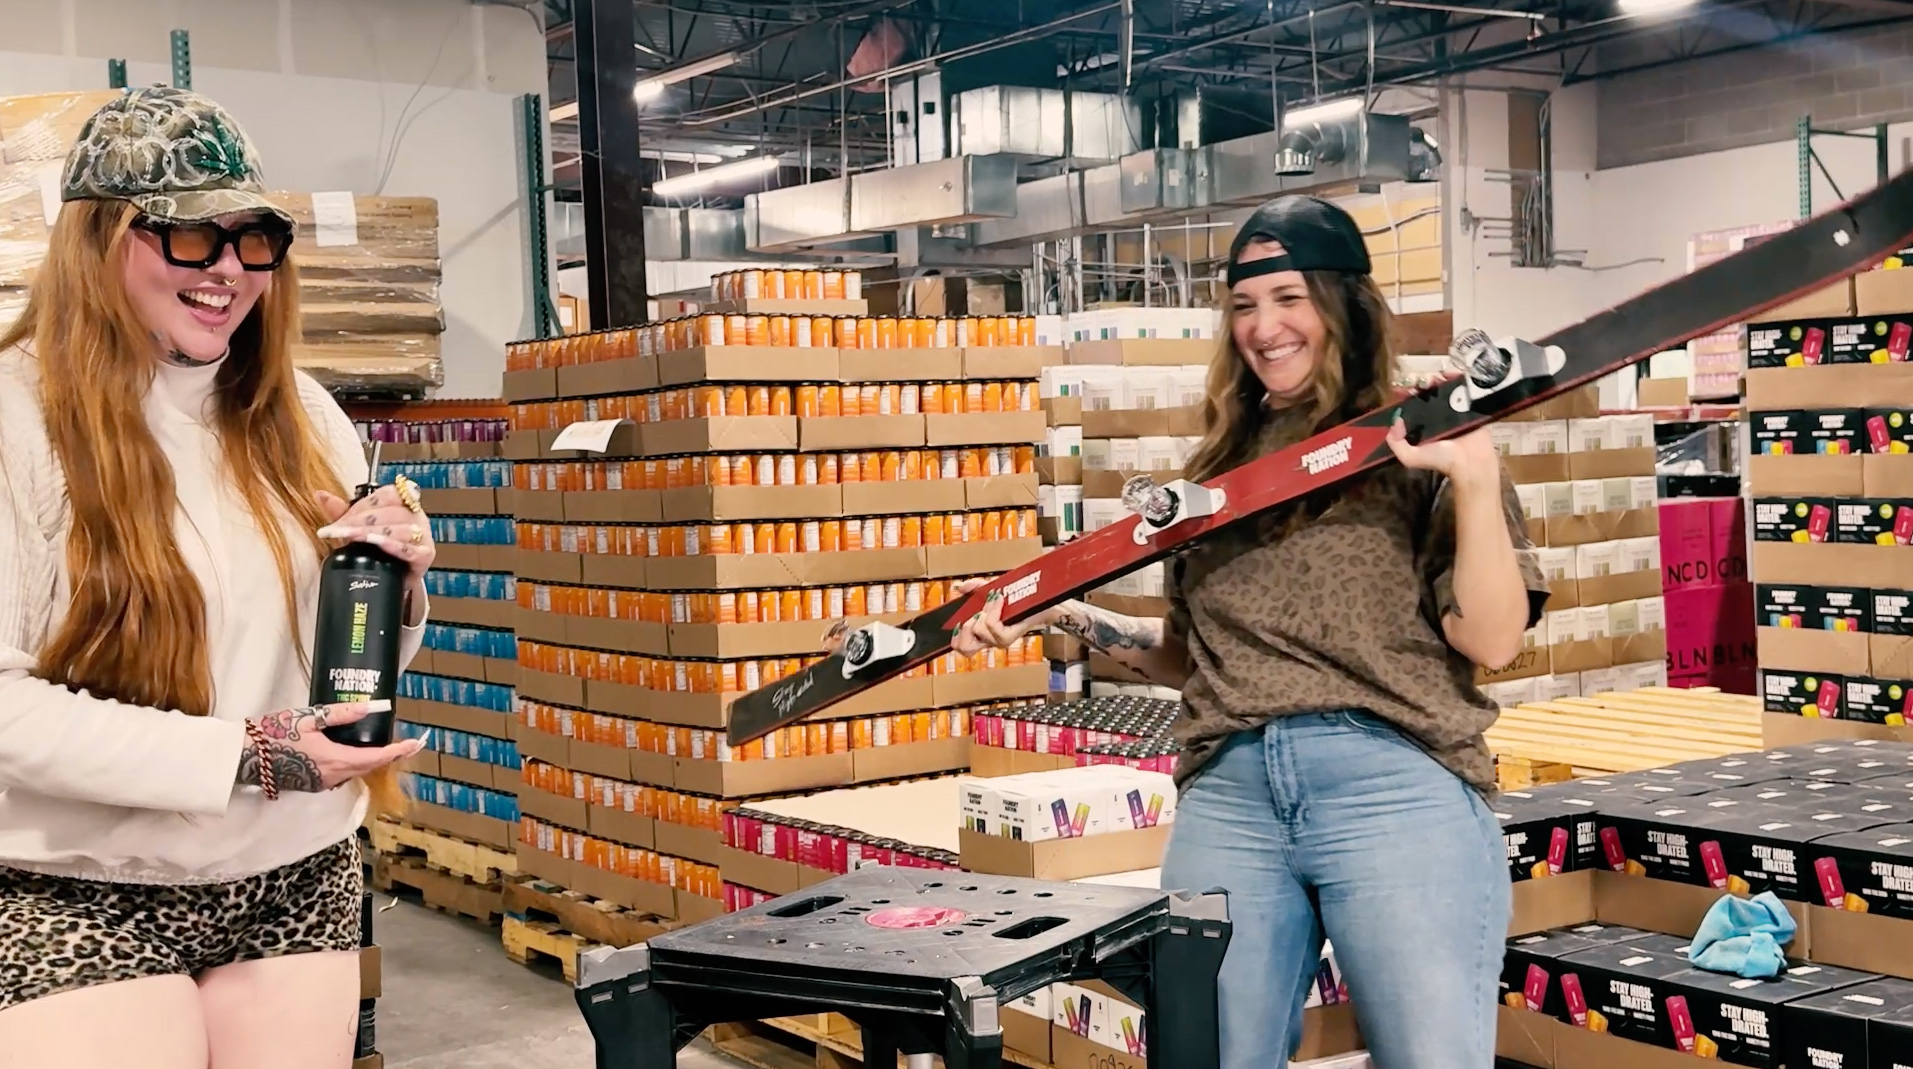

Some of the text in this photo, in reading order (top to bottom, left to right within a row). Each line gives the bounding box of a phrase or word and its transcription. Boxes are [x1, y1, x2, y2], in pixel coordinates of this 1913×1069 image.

[1301, 436, 1353, 468] FOUNDRY
[1309, 448, 1349, 475] NATION
[1003, 570, 1041, 598] FOUNDRY
[1008, 581, 1038, 606] NATION
[351, 602, 368, 654] LEMON HAZE
[329, 667, 381, 683] FOUNDRY
[1647, 830, 1689, 846] STAY HIGH-
[1657, 844, 1689, 859] DRATED.
[1752, 845, 1797, 862] STAY HIGH-
[1762, 858, 1797, 875] DRATED.
[1871, 861, 1893, 876] STAY
[1882, 875, 1913, 892] DRATE
[1610, 980, 1654, 998] STAY HIGH-
[1620, 995, 1655, 1013] DRATED.
[1720, 1003, 1769, 1024] STAY HIGH-
[1732, 1019, 1770, 1039] DRATED.
[1807, 1047, 1843, 1063] FOUNDRY
